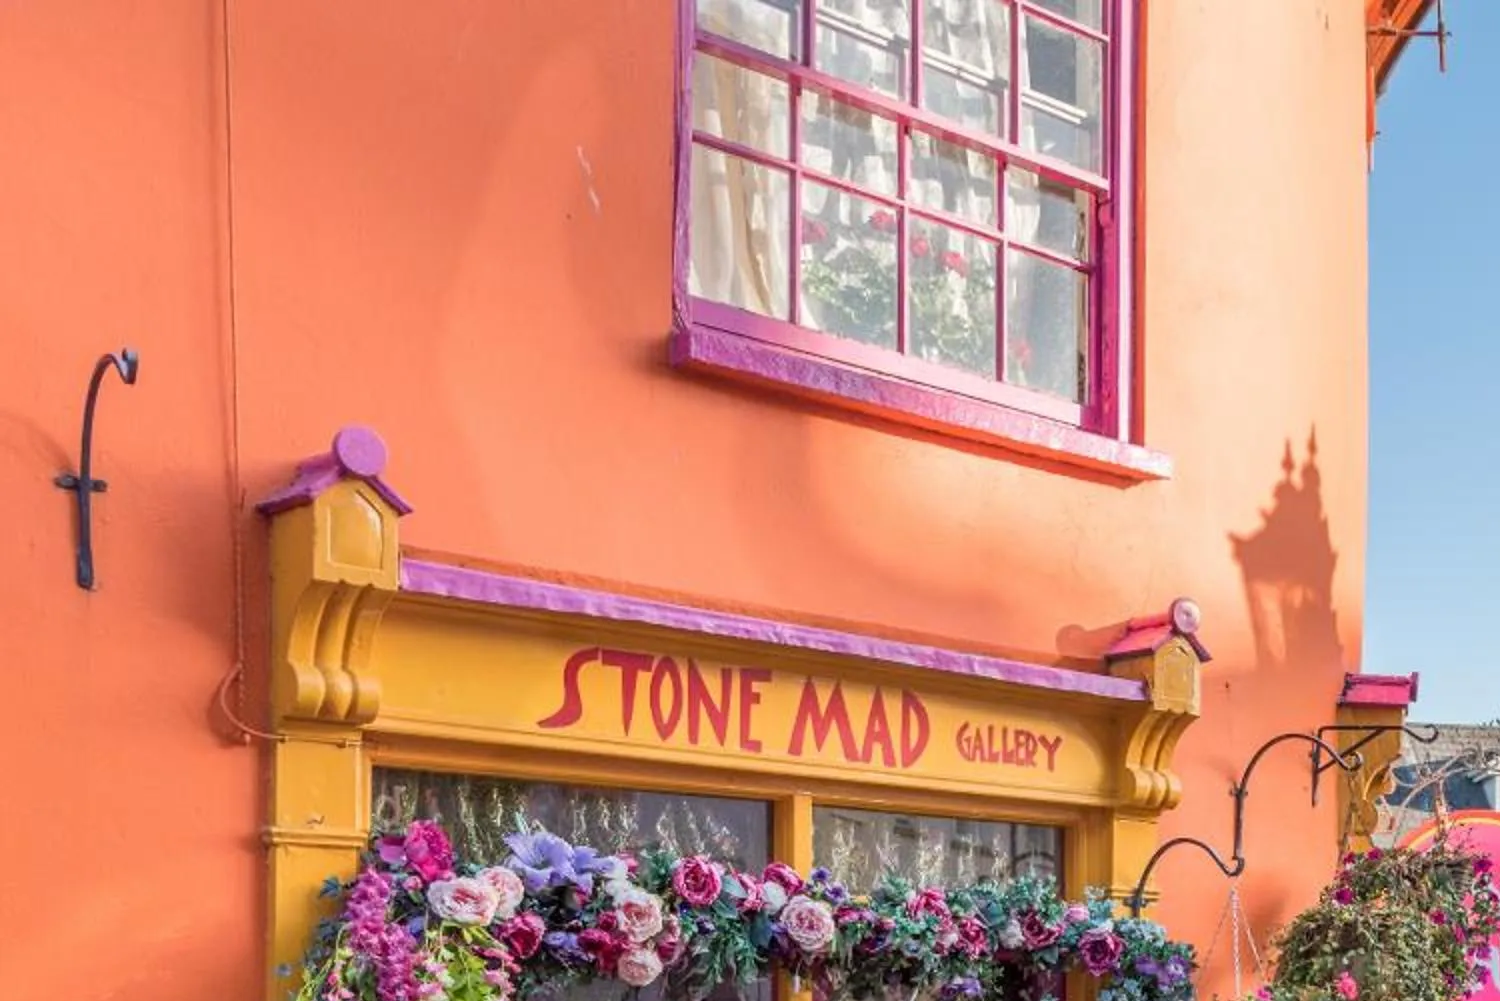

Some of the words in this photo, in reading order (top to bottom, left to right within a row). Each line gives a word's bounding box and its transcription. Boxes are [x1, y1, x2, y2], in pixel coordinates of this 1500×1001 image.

[538, 646, 772, 754] STONE
[787, 676, 931, 769] MAD
[955, 720, 1064, 772] GALLERY
